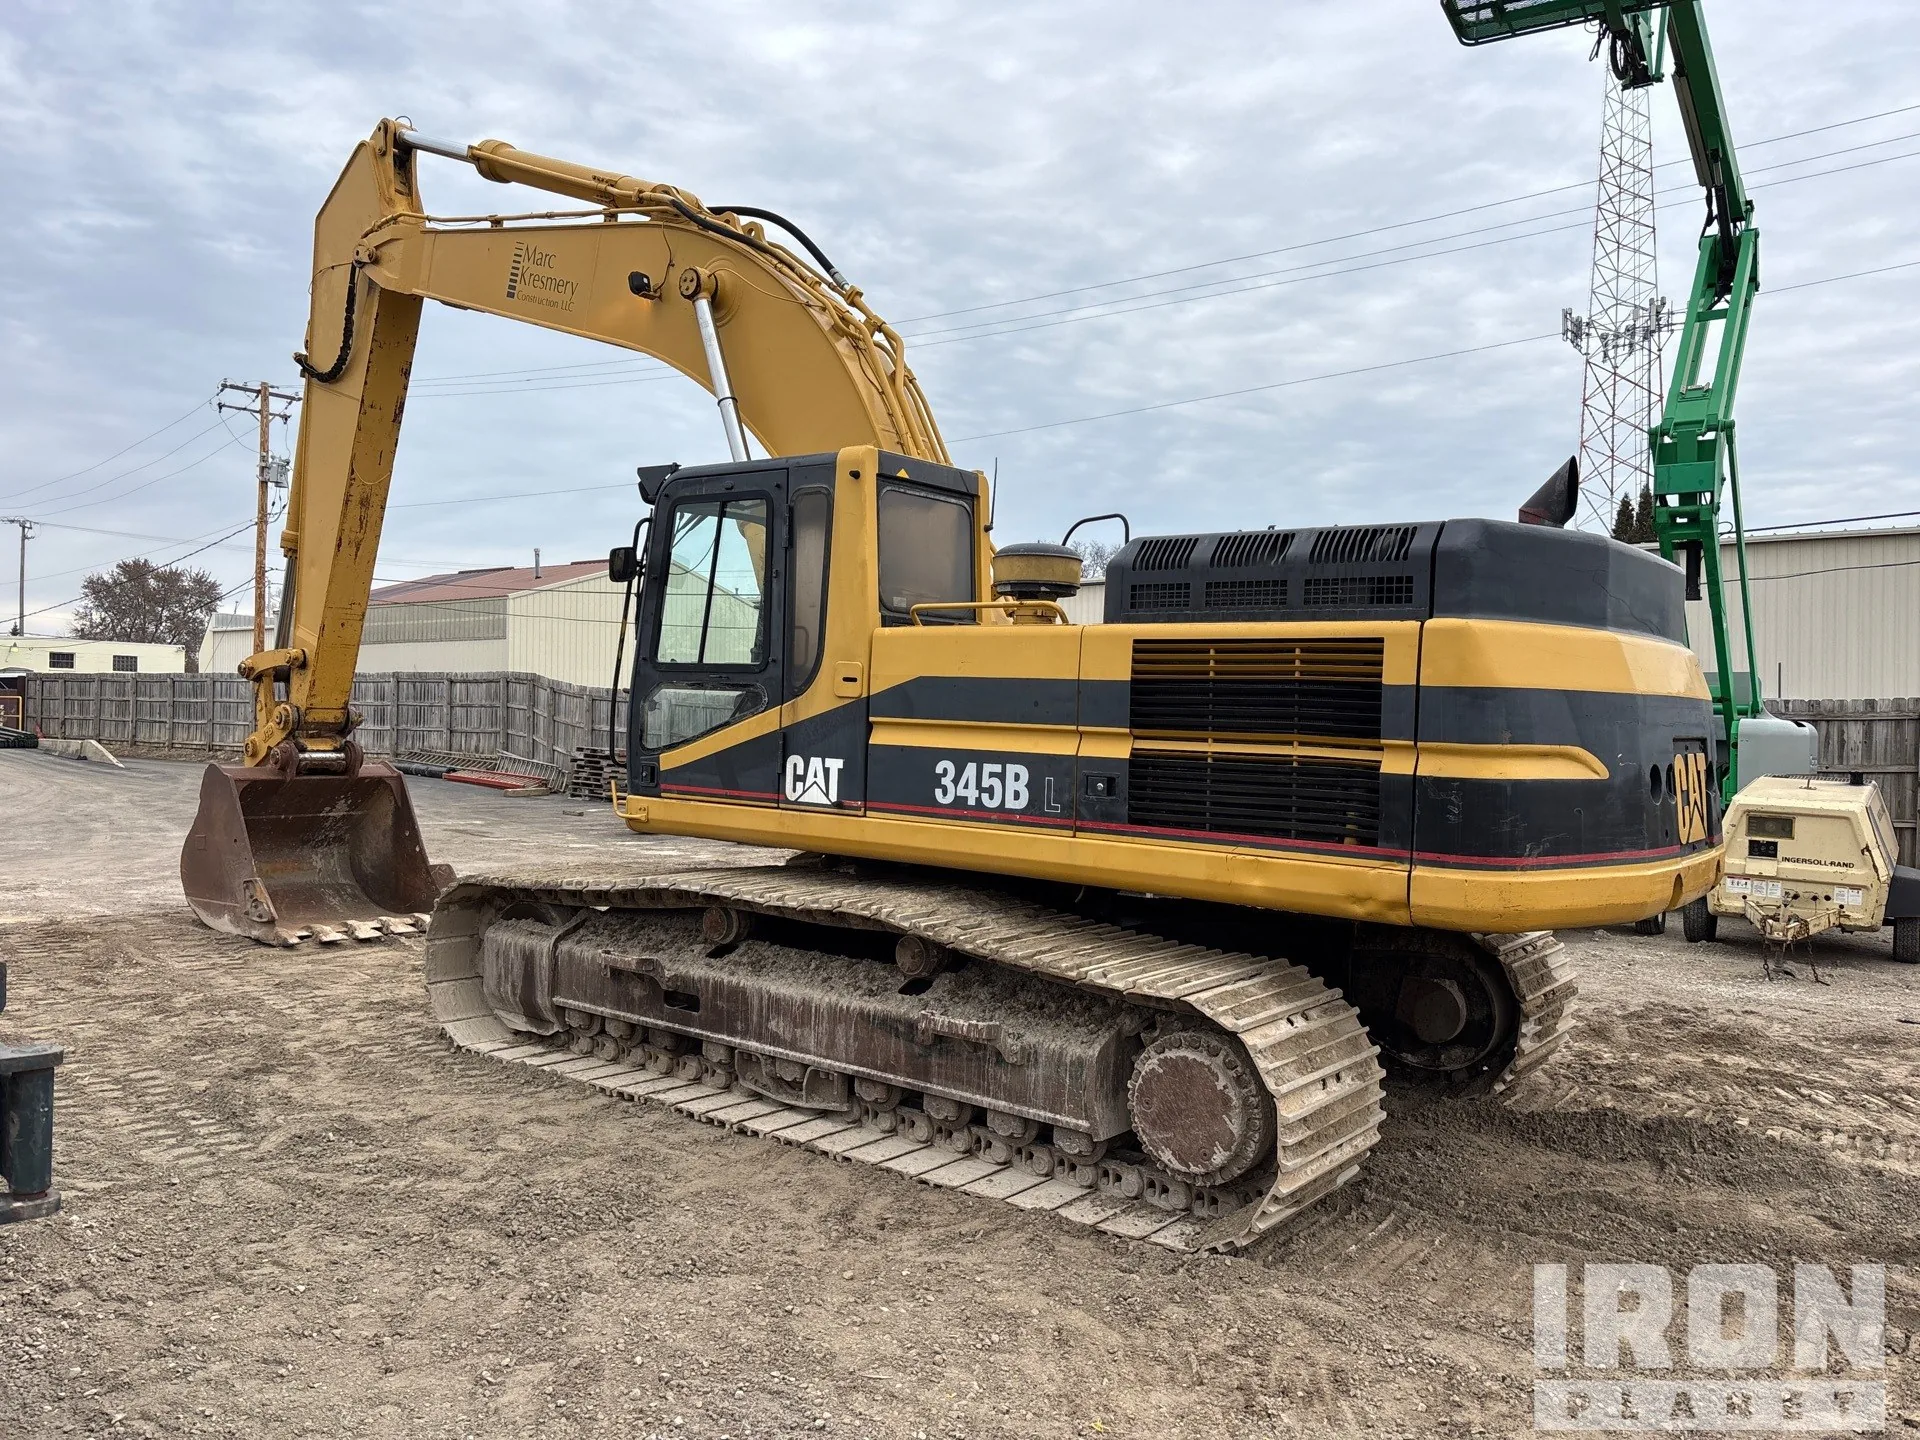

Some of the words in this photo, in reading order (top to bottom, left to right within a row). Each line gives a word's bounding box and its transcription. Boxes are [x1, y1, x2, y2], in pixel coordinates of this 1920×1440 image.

[522, 244, 556, 269] Marc
[516, 290, 559, 308] Construction
[560, 299, 574, 312] LLC
[519, 265, 579, 301] Kresmery
[785, 755, 844, 804] CAT
[934, 760, 1029, 809] 345B
[1045, 777, 1061, 812] L
[1674, 753, 1707, 845] CAT
[1781, 856, 1855, 869] INGERSOLL-RAND
